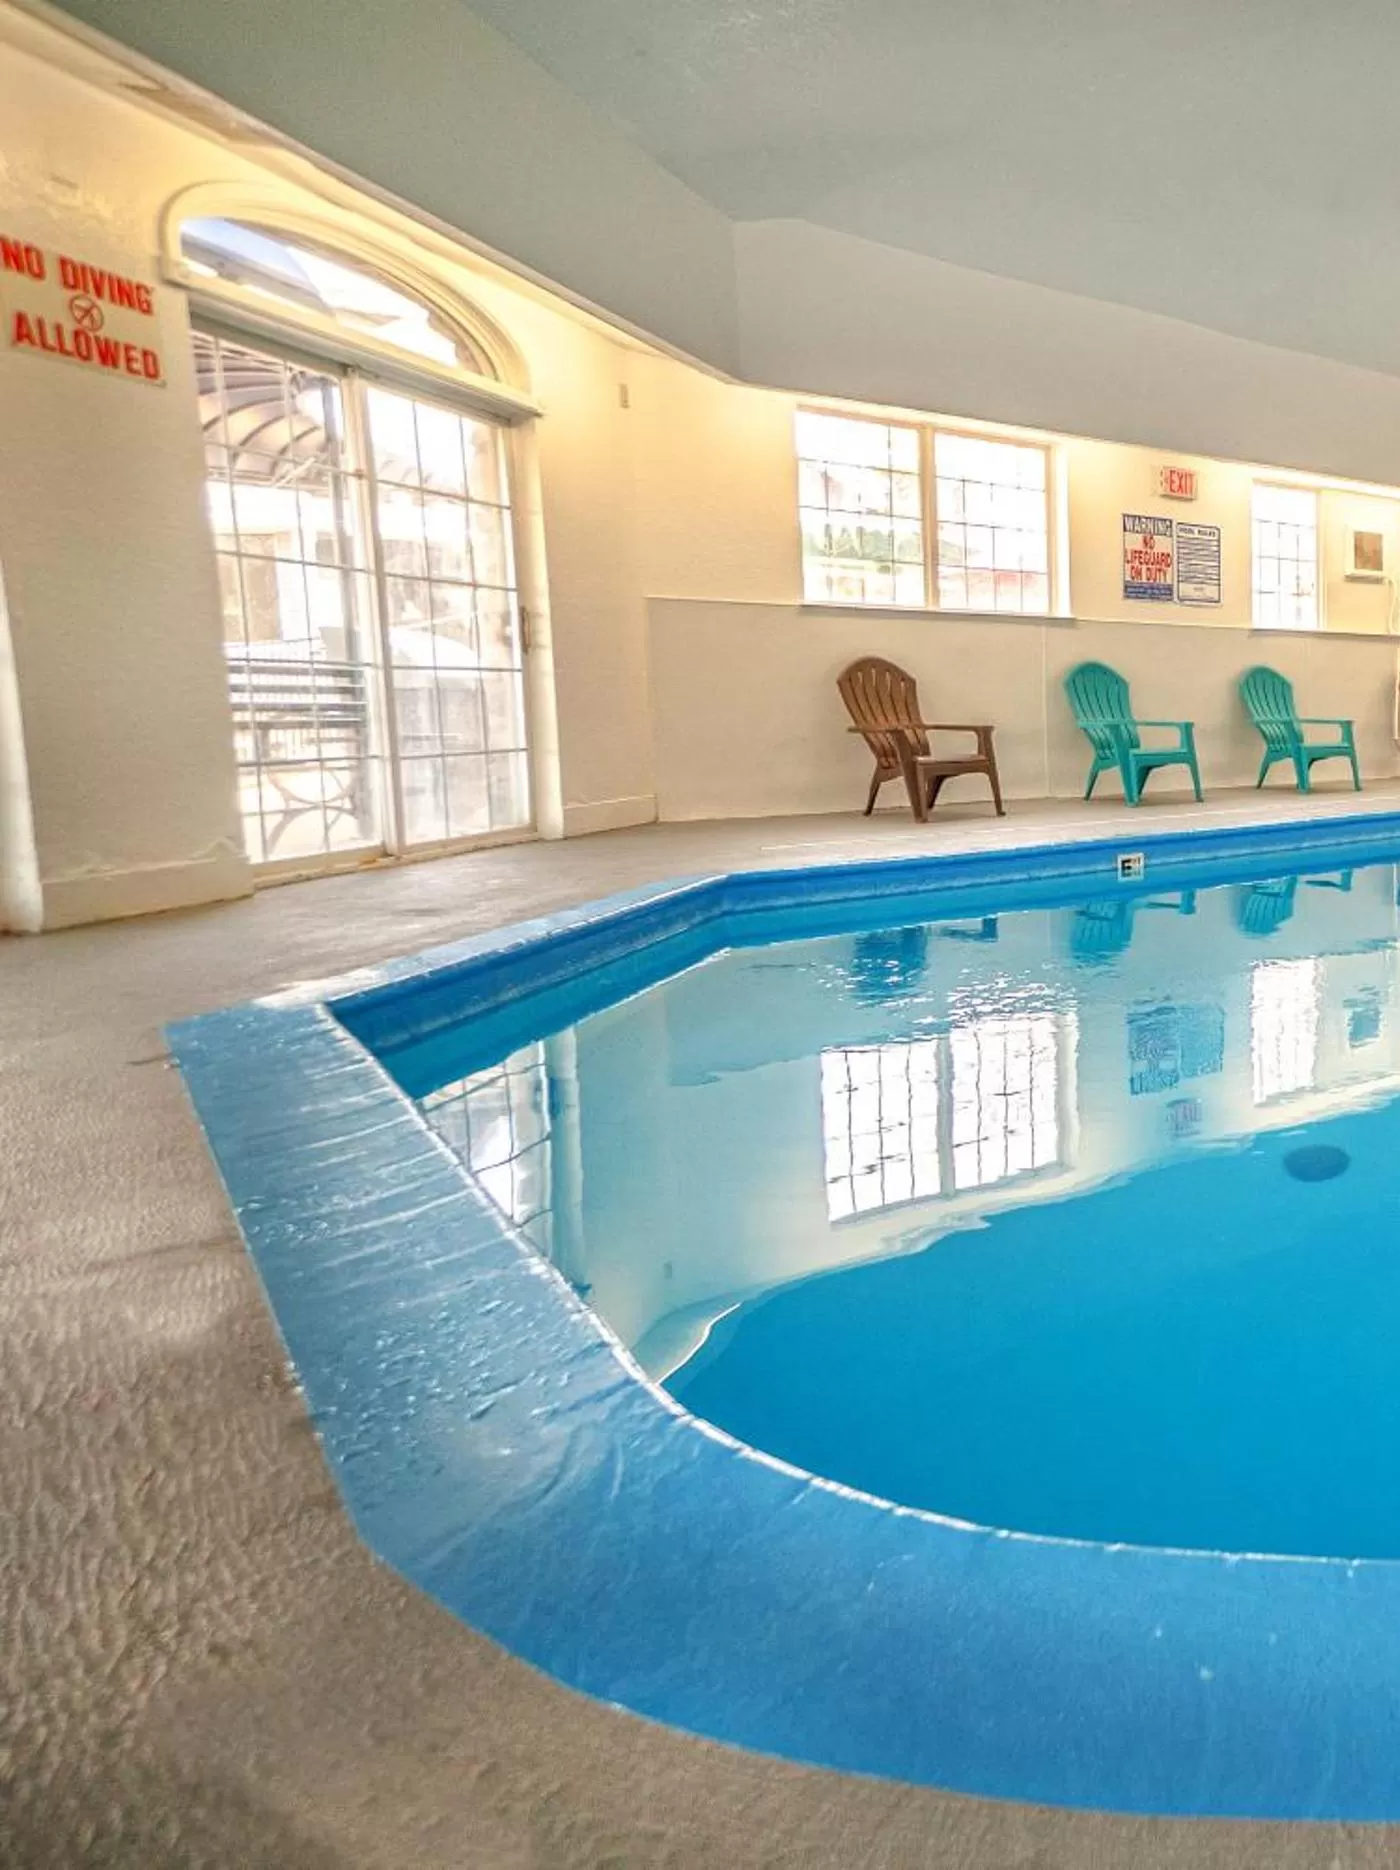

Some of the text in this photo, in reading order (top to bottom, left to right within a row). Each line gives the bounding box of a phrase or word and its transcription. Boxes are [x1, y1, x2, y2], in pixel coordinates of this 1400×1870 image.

[0, 234, 154, 316] NO DIVING
[12, 312, 160, 380] ALLOWED
[1169, 469, 1195, 495] EXIT
[1124, 515, 1171, 536] WARNING
[1143, 535, 1155, 550] NO
[1124, 549, 1171, 568] LIFEGUARD
[1131, 565, 1168, 583] ON DUTY
